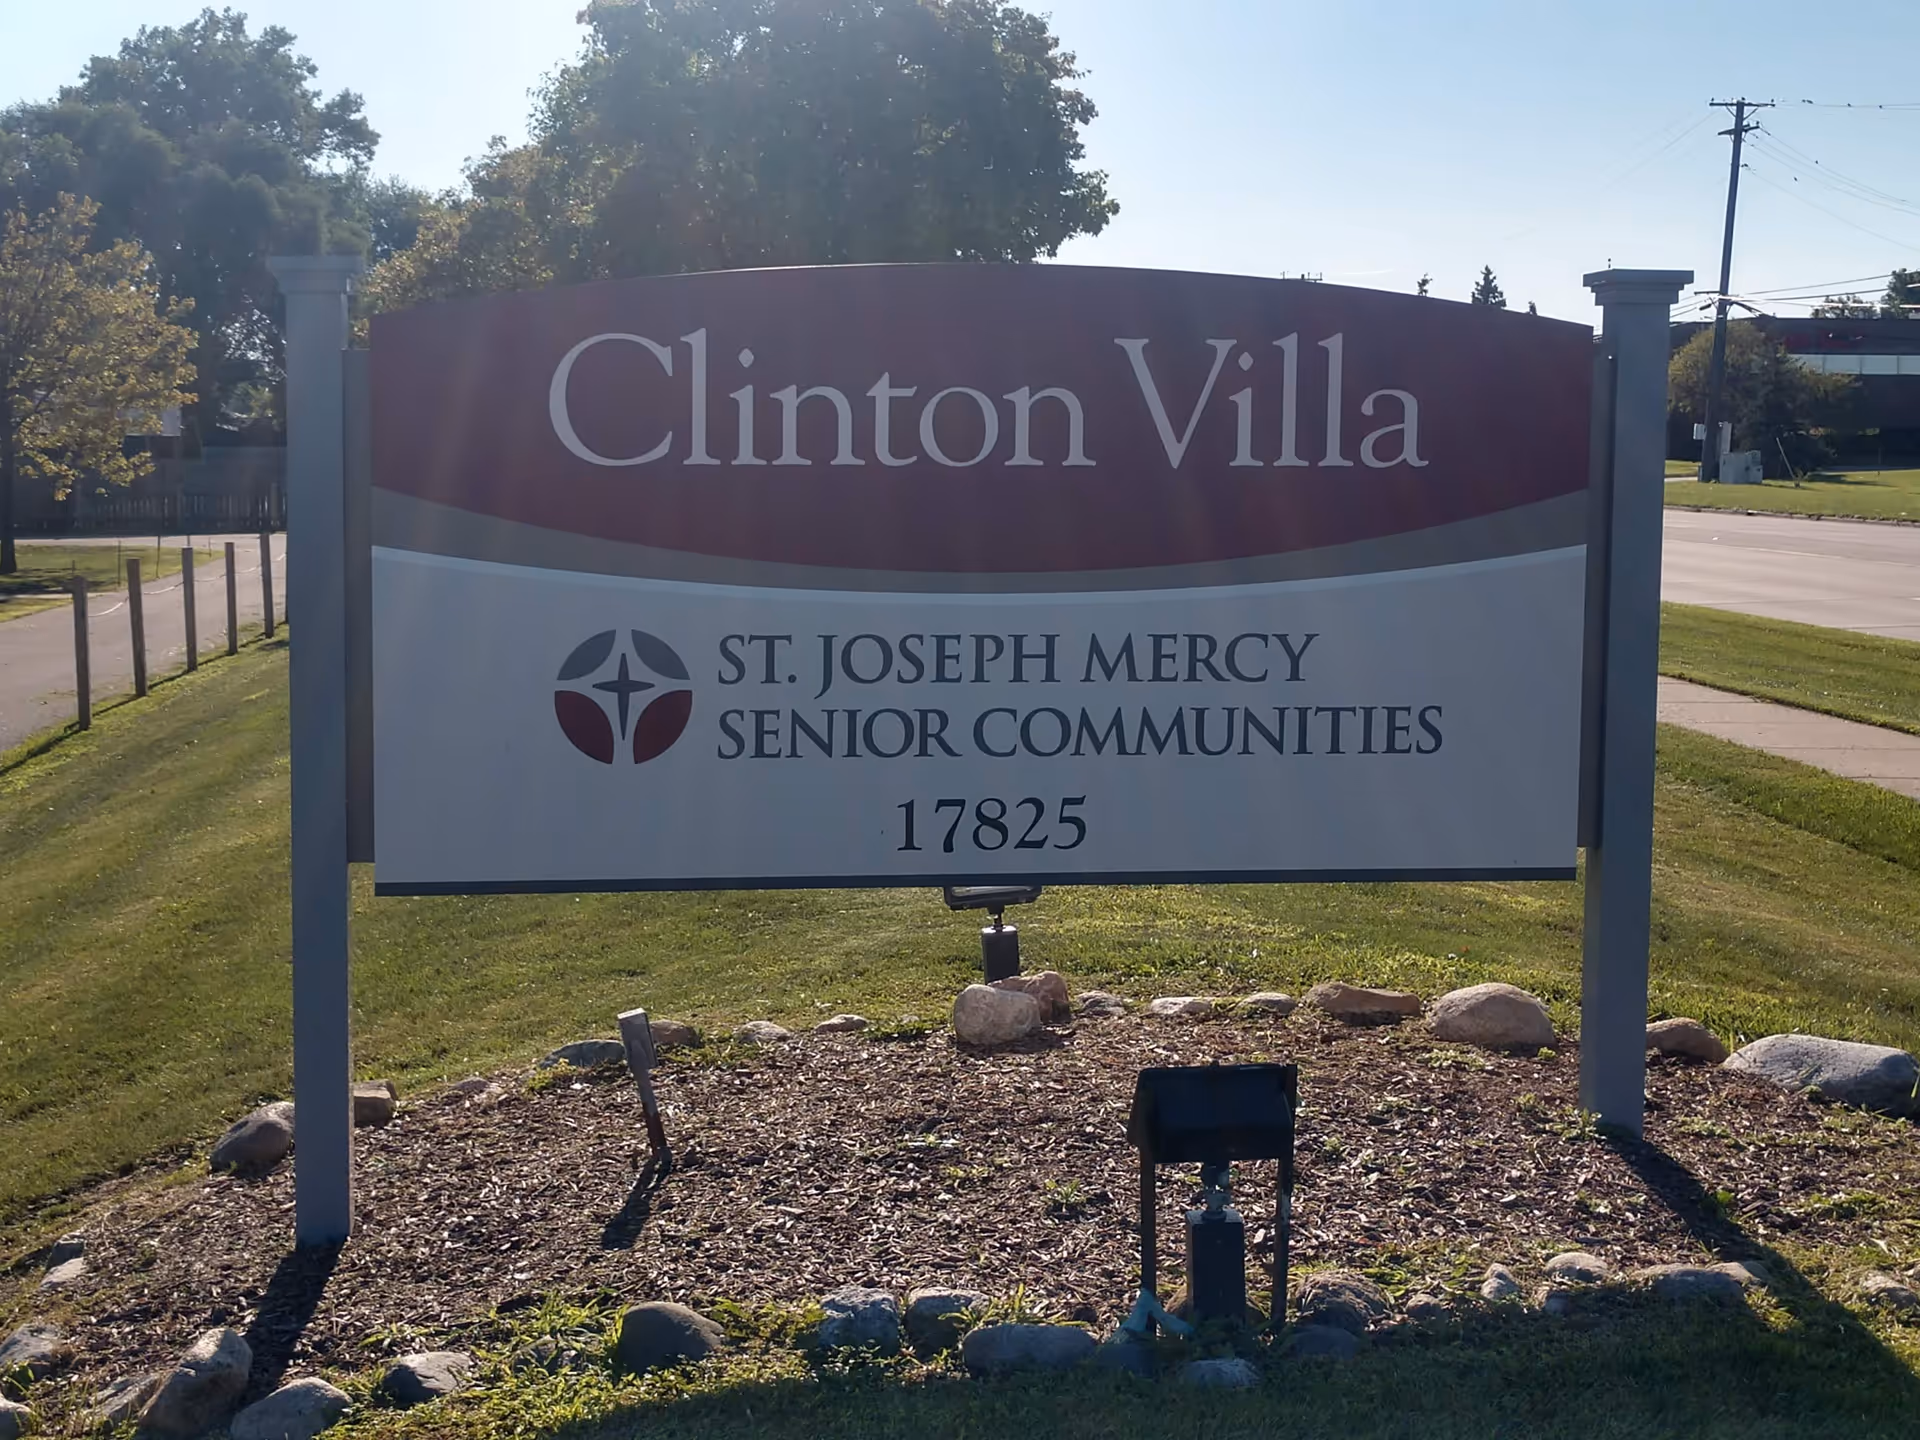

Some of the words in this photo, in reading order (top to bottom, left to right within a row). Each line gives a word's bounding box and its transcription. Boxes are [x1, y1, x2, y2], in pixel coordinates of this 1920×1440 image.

[549, 328, 1097, 467] Clinton
[1113, 332, 1429, 469] Villa
[717, 634, 798, 685] ST.
[814, 633, 1061, 699] JOSEPH
[1080, 633, 1320, 683] MERCY
[716, 707, 963, 760] SENIOR
[973, 705, 1444, 758] COMMUNITIES
[896, 795, 1088, 854] 17825
